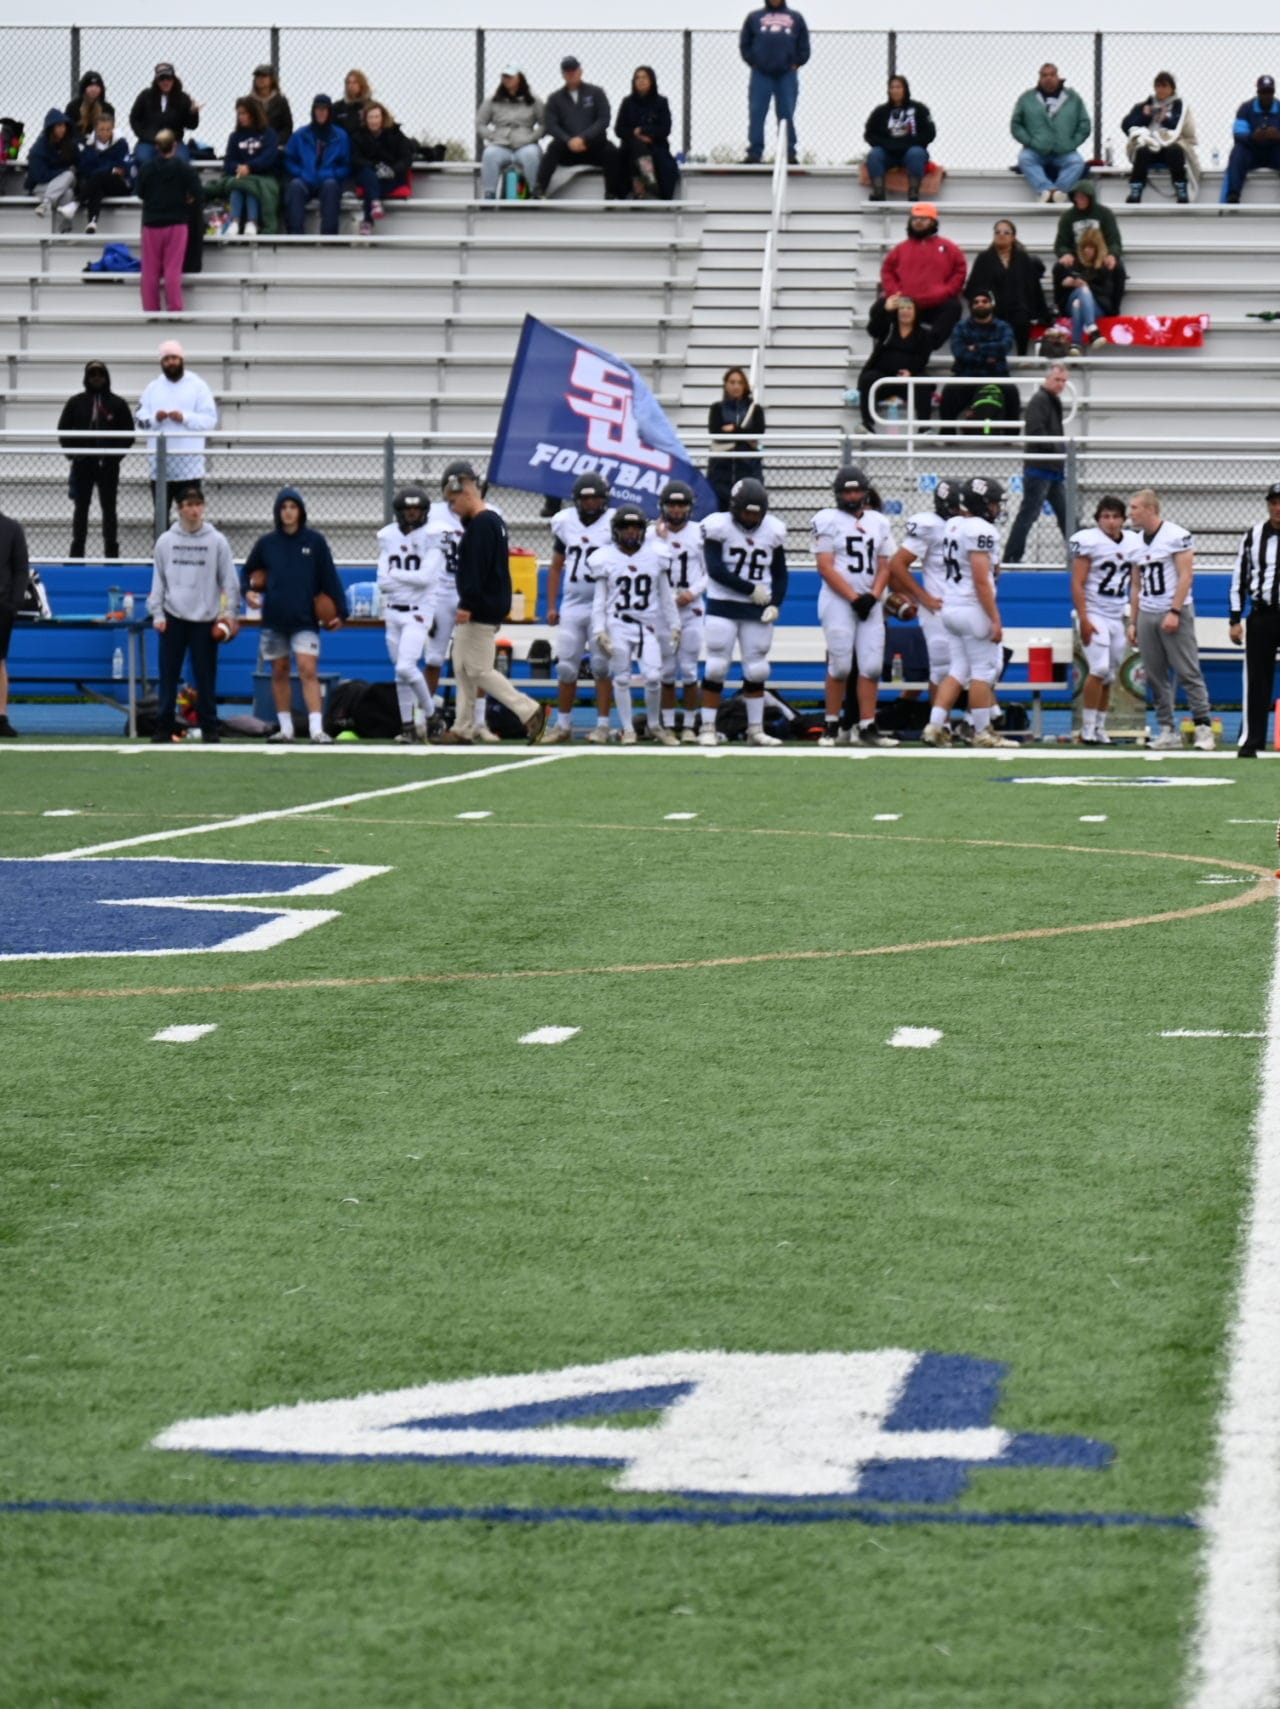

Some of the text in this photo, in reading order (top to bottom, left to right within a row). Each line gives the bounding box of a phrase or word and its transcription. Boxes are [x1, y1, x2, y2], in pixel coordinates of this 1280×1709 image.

[846, 536, 875, 575] 51
[977, 534, 994, 549] 66
[729, 546, 768, 581] 76
[615, 574, 652, 611] 39
